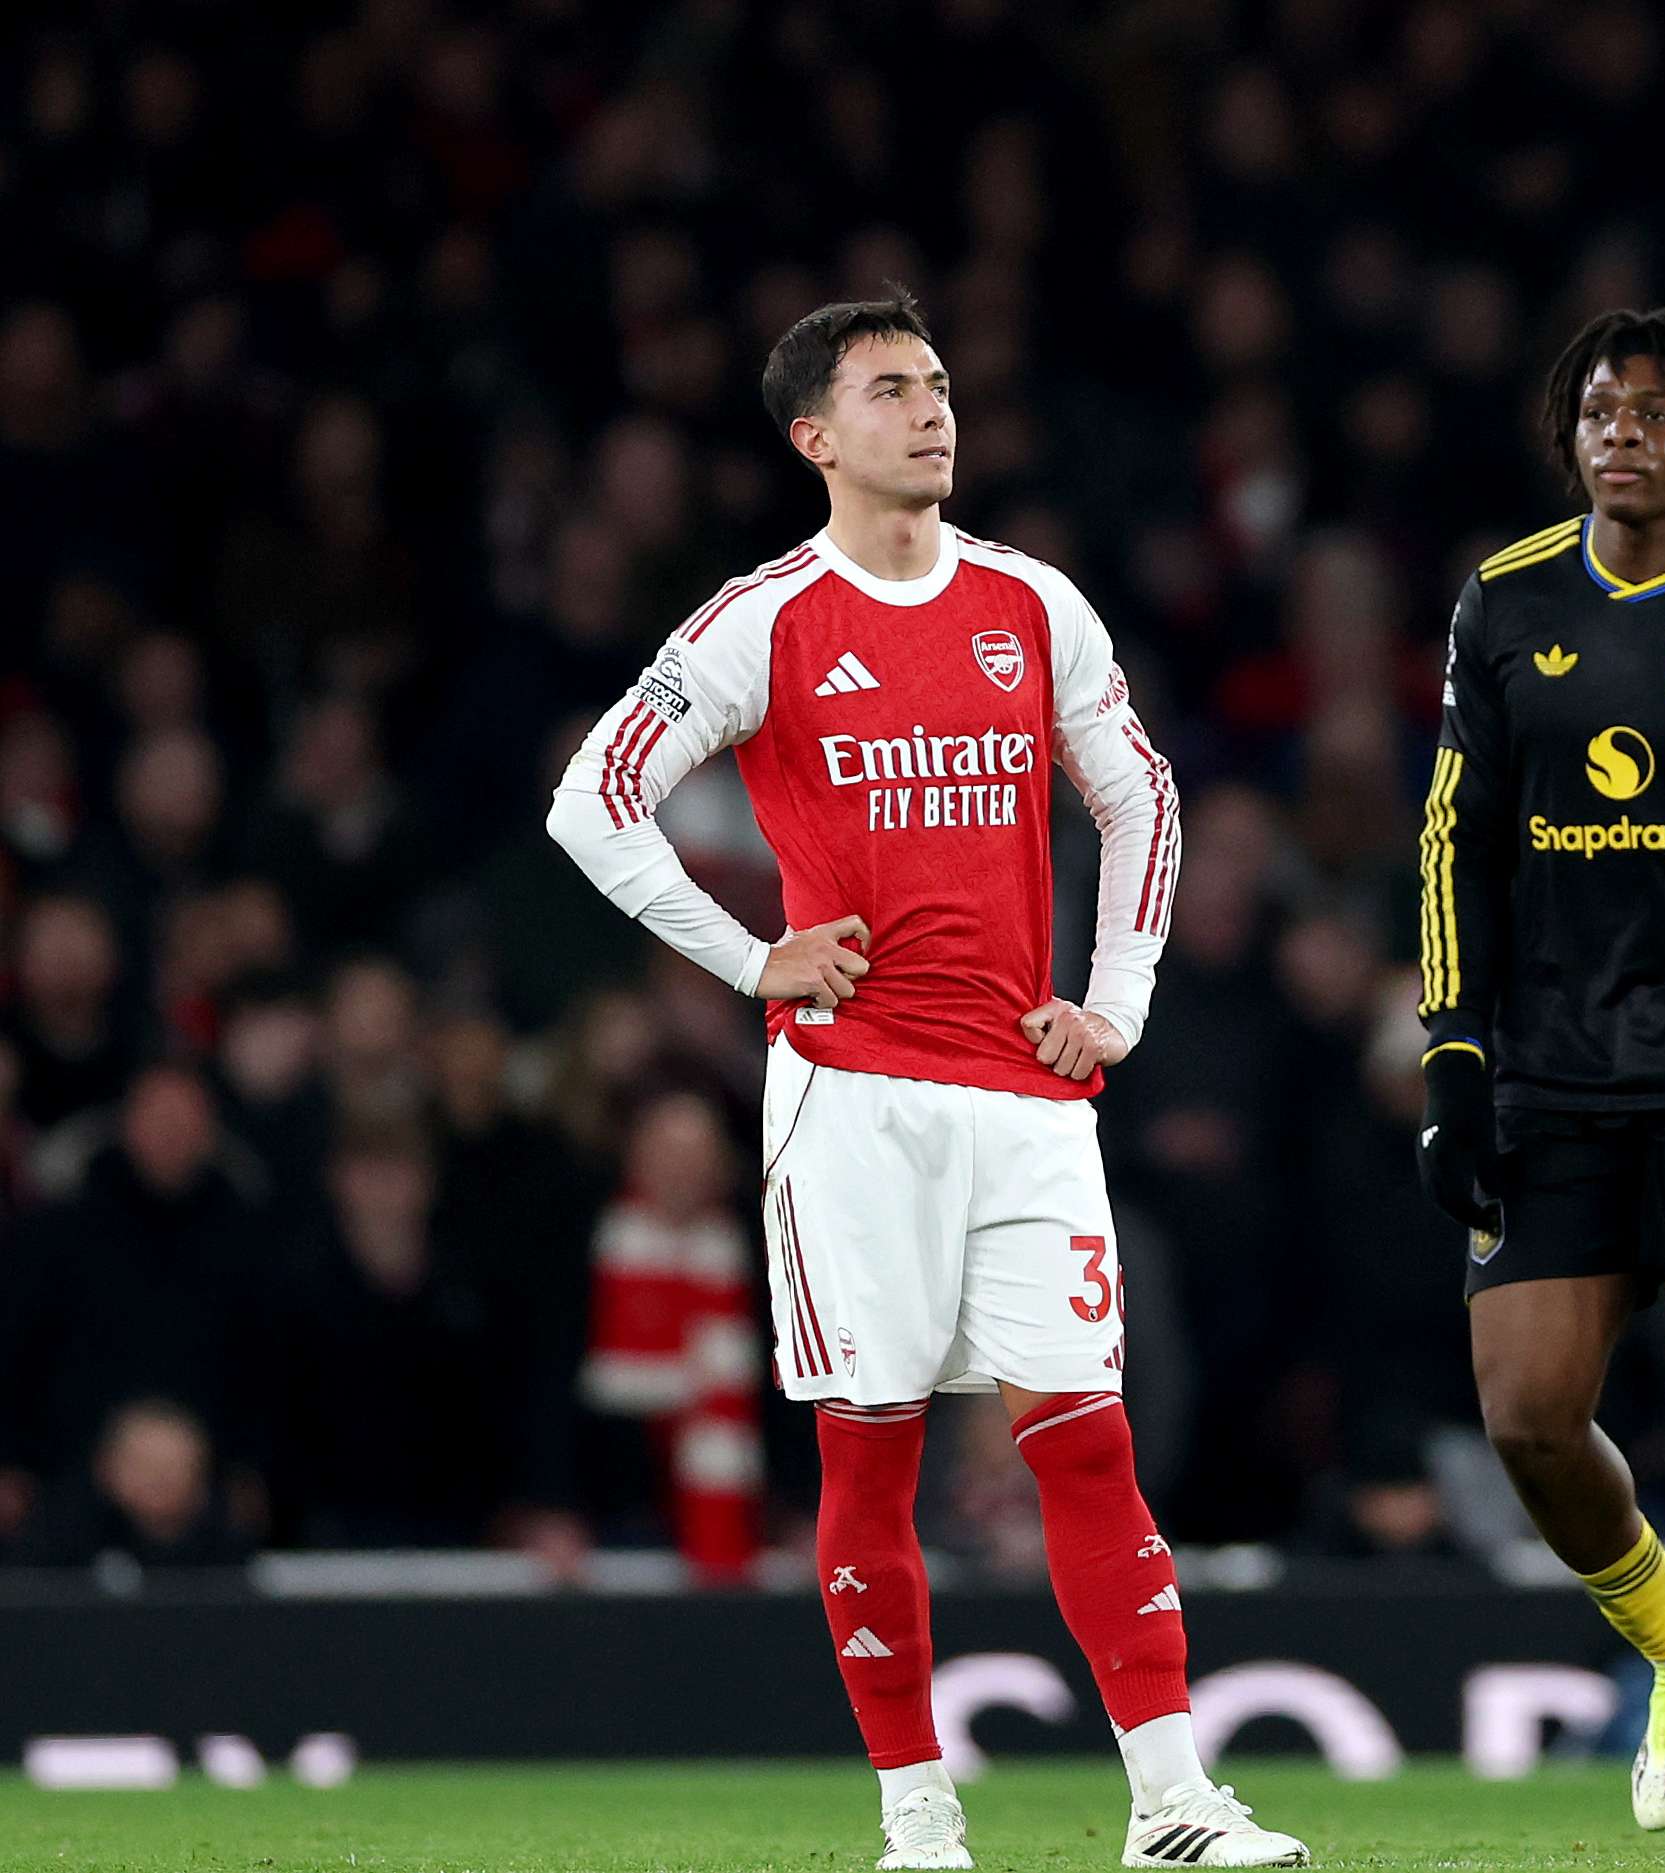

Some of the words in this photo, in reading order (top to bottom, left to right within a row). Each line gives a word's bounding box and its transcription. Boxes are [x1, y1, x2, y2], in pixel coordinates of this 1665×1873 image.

[643, 690, 684, 724] racism
[652, 679, 685, 711] room
[820, 723, 1035, 786] Emirates
[868, 788, 911, 832] FLY
[923, 784, 1018, 828] BETTER
[1068, 1236, 1124, 1323] 3
